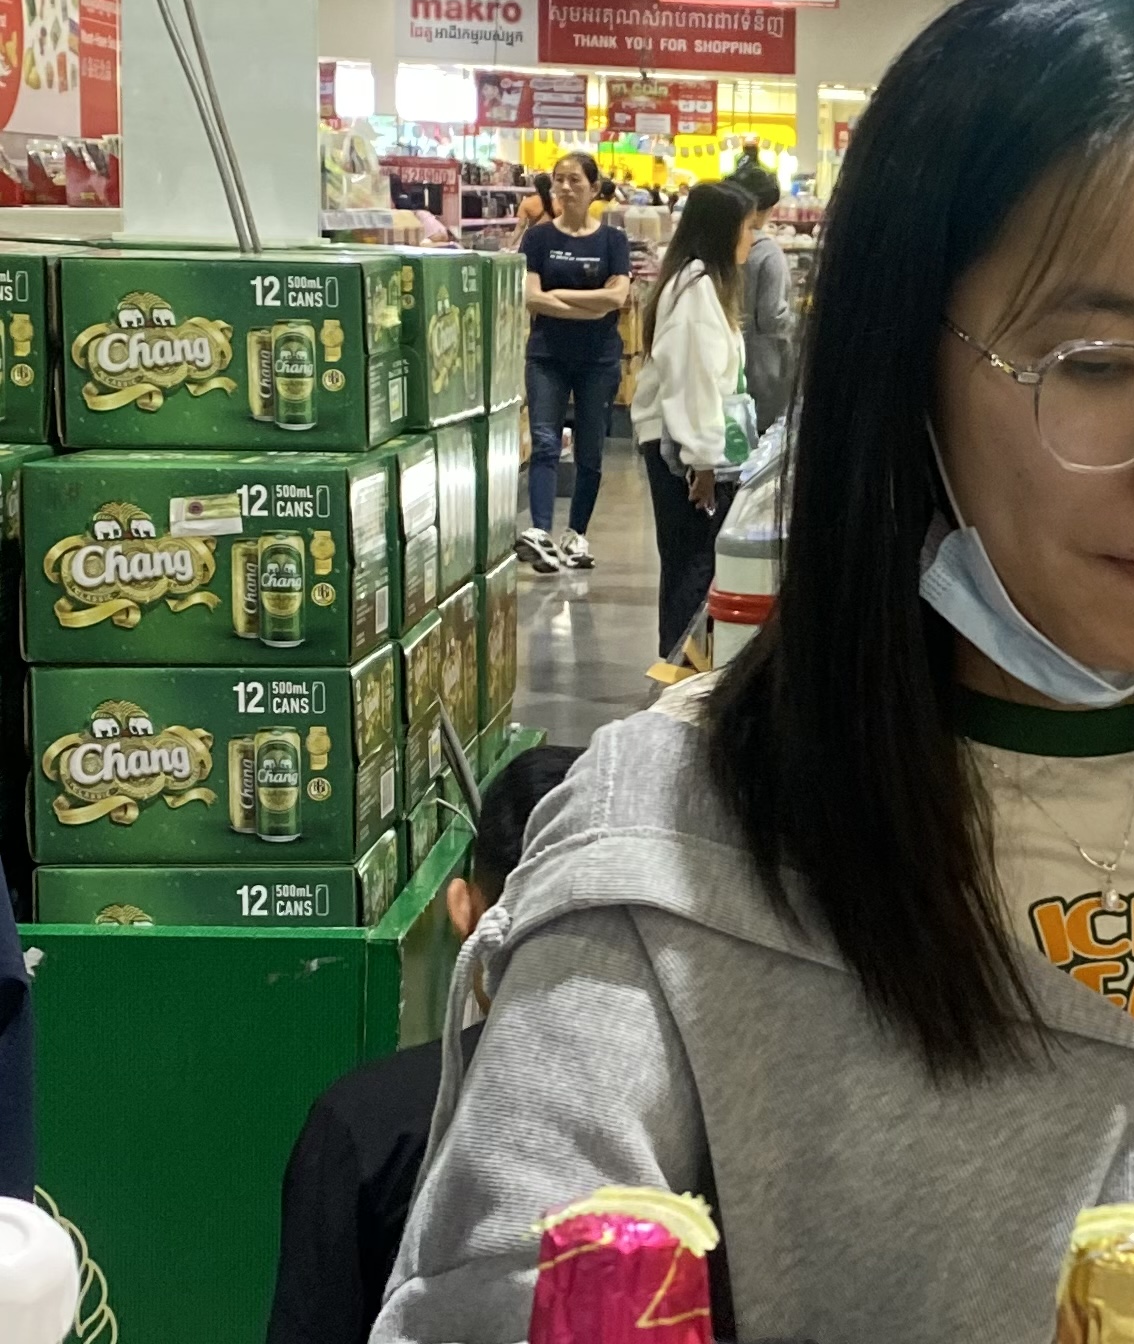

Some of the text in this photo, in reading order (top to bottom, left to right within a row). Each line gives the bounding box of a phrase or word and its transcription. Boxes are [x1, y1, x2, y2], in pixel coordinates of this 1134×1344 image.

[573, 34, 762, 55] THANK YOU FOR SHOPPING
[251, 276, 323, 307] 12 500mL
[288, 293, 322, 307] CANS
[98, 332, 211, 372] Chang
[274, 359, 314, 377] Chang
[236, 484, 313, 517] 12 500mL
[276, 502, 313, 518] CANS
[71, 544, 194, 587] Chang
[261, 571, 302, 590] Chang
[232, 681, 309, 714] 12 500mL
[272, 698, 309, 714] CANS
[69, 742, 191, 784] Chang
[257, 768, 298, 786] Chang
[236, 884, 314, 917] 12 500mL
[276, 901, 313, 916] CANS
